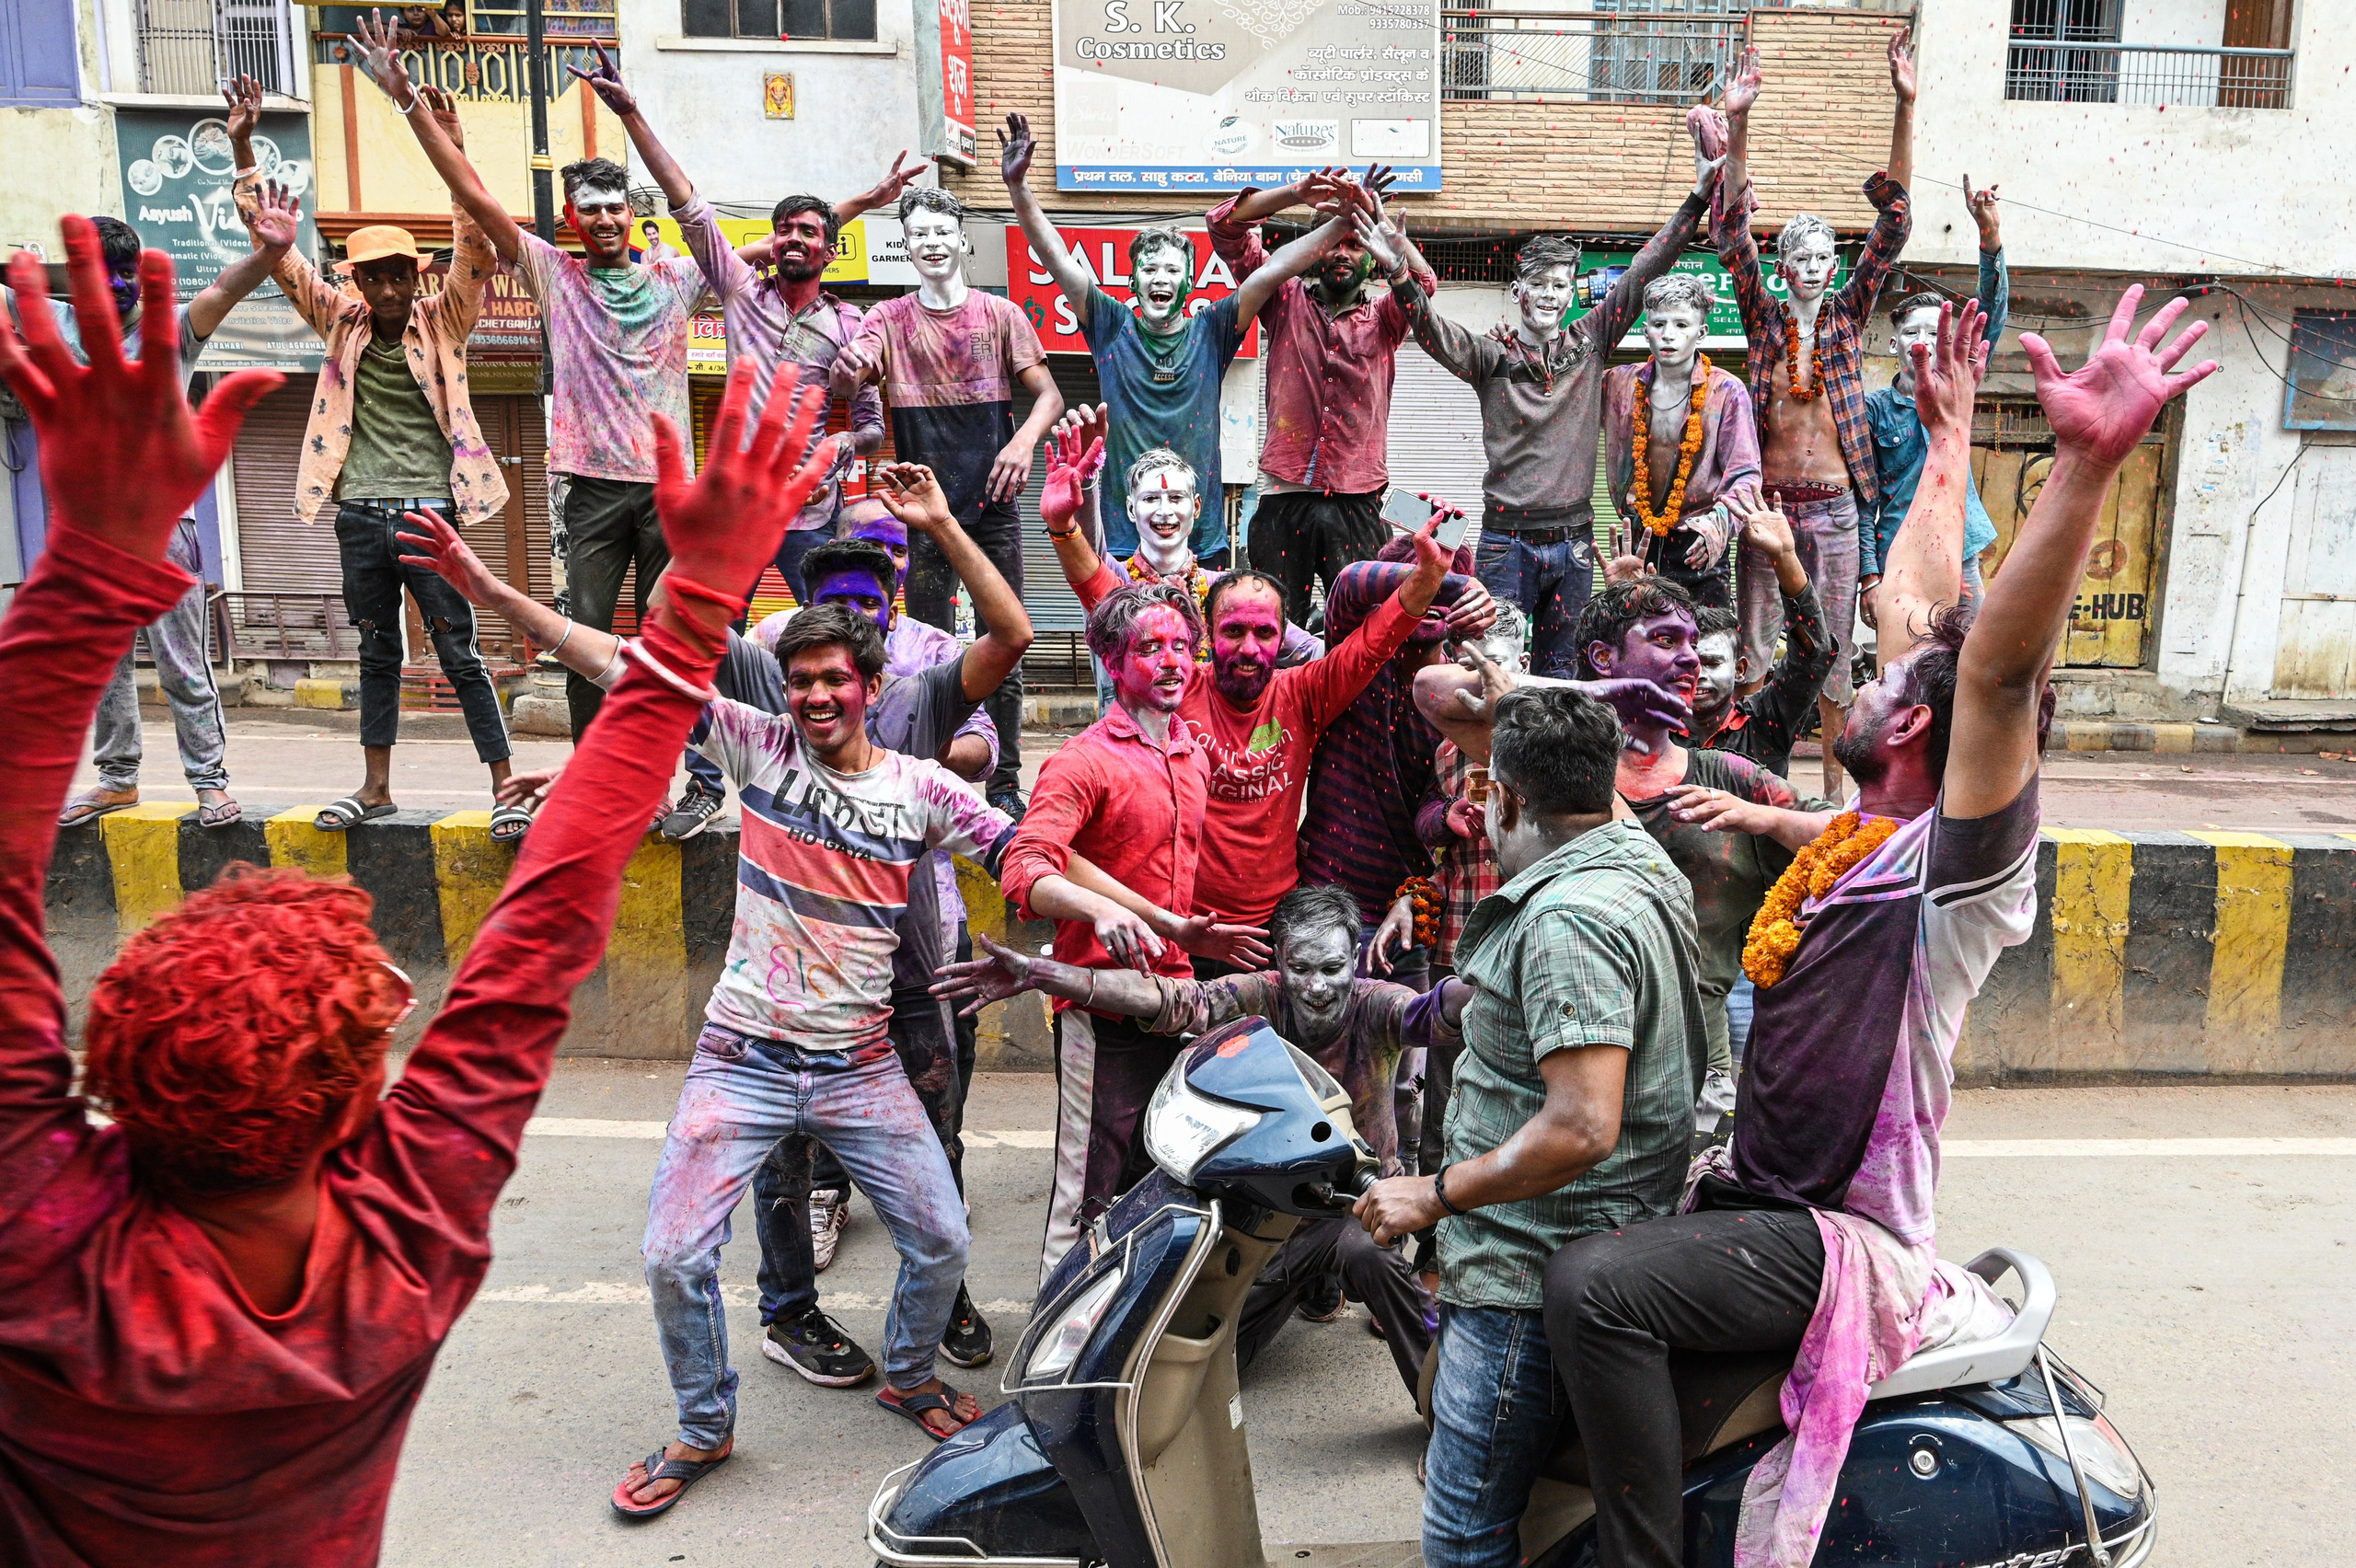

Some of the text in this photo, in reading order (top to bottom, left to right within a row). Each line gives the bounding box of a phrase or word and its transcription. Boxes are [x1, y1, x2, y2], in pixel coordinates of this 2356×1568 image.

[1104, 0, 1196, 33] S. K.
[1369, 5, 1430, 16] 9415228378
[1369, 18, 1430, 29] 9335780337
[1076, 37, 1226, 60] Cosmetics
[1308, 44, 1430, 64] ब्यूटी पार्लर, सैलून व
[1294, 65, 1357, 81] कॉस्मेटिक
[1415, 66, 1429, 81] के
[1245, 87, 1431, 108] थोक विक्रेता एवं सुपर स्टॉकिस्ट
[1214, 134, 1248, 146] NATURE
[1073, 171, 1106, 184] प्रथम
[1109, 171, 1137, 183] तल,
[1140, 171, 1169, 187] साहु
[1213, 168, 1253, 183] बेनिया
[1255, 171, 1283, 183] बाग
[138, 204, 193, 225] Aayush
[172, 238, 217, 247] Traditional
[491, 301, 538, 317] HARD
[971, 343, 991, 355] ER
[972, 354, 994, 363] SPO
[1153, 373, 1175, 381] ACCESS
[1212, 753, 1285, 784] ASSIC
[1210, 771, 1293, 800] IGINAL
[787, 826, 872, 863] HO GAYA
